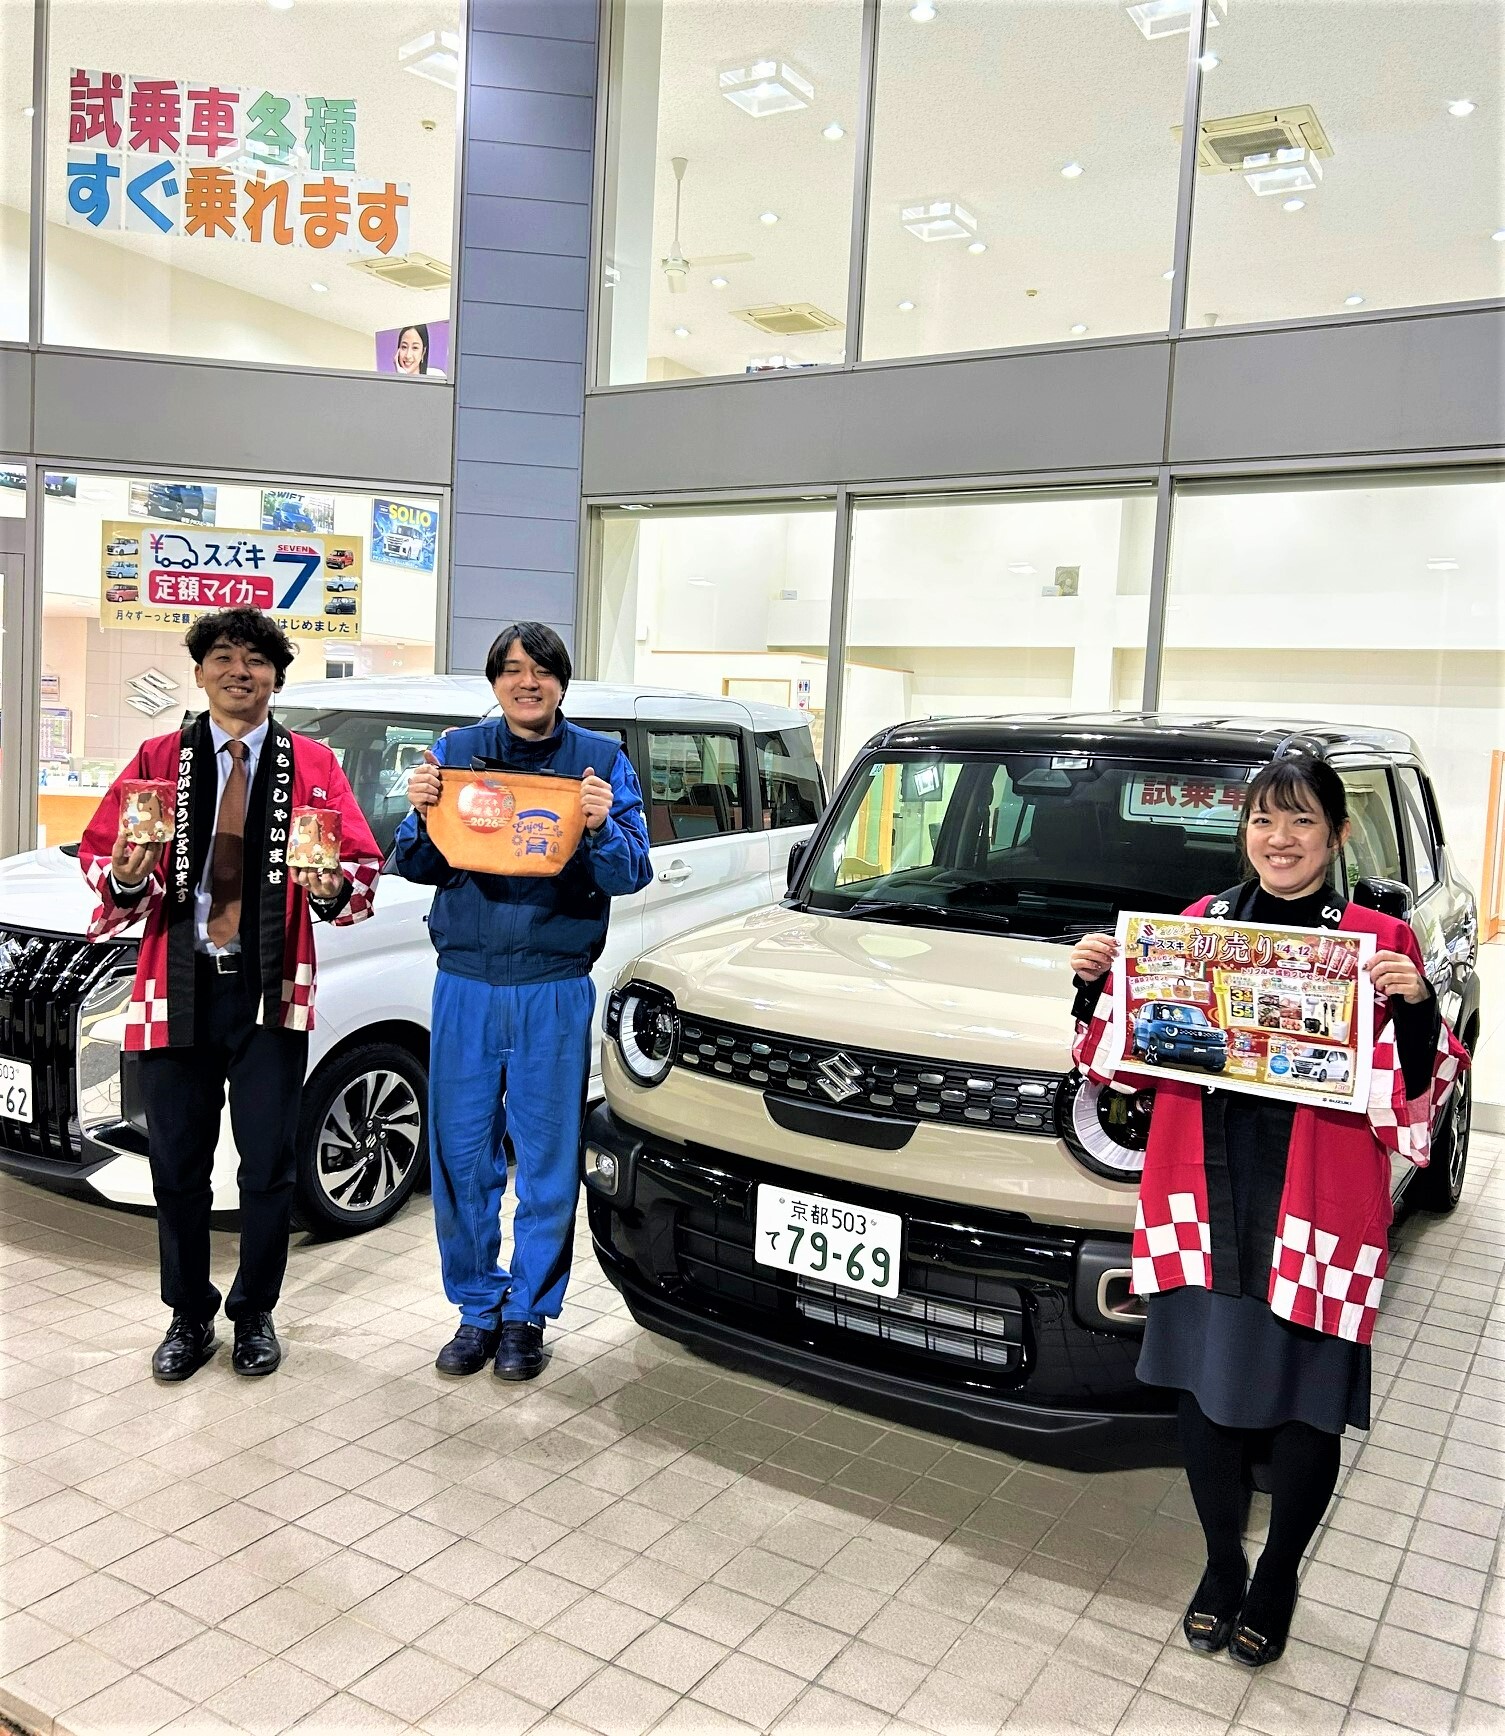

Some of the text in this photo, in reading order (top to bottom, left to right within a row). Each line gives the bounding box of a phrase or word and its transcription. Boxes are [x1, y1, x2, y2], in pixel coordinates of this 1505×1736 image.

[69, 68, 357, 172] 試乗車各種
[67, 152, 409, 255] すぐ乗れます
[268, 491, 305, 503] SWIFT
[389, 503, 431, 527] SOLIO
[203, 541, 266, 569] スズキ
[277, 543, 310, 554] SEVEN
[154, 574, 269, 604] 定額マイカー
[272, 553, 321, 609] 7
[266, 734, 291, 886] いらっしゃいませ
[1141, 775, 1247, 811] 試乗車
[174, 746, 195, 904] ありがとうございます
[470, 817, 499, 828] 2026
[512, 821, 549, 833] Enjoy
[1156, 939, 1185, 951] スズキ
[1187, 927, 1273, 966] 初売り
[790, 1200, 867, 1236] 京都503
[765, 1224, 891, 1288] て 79-69
